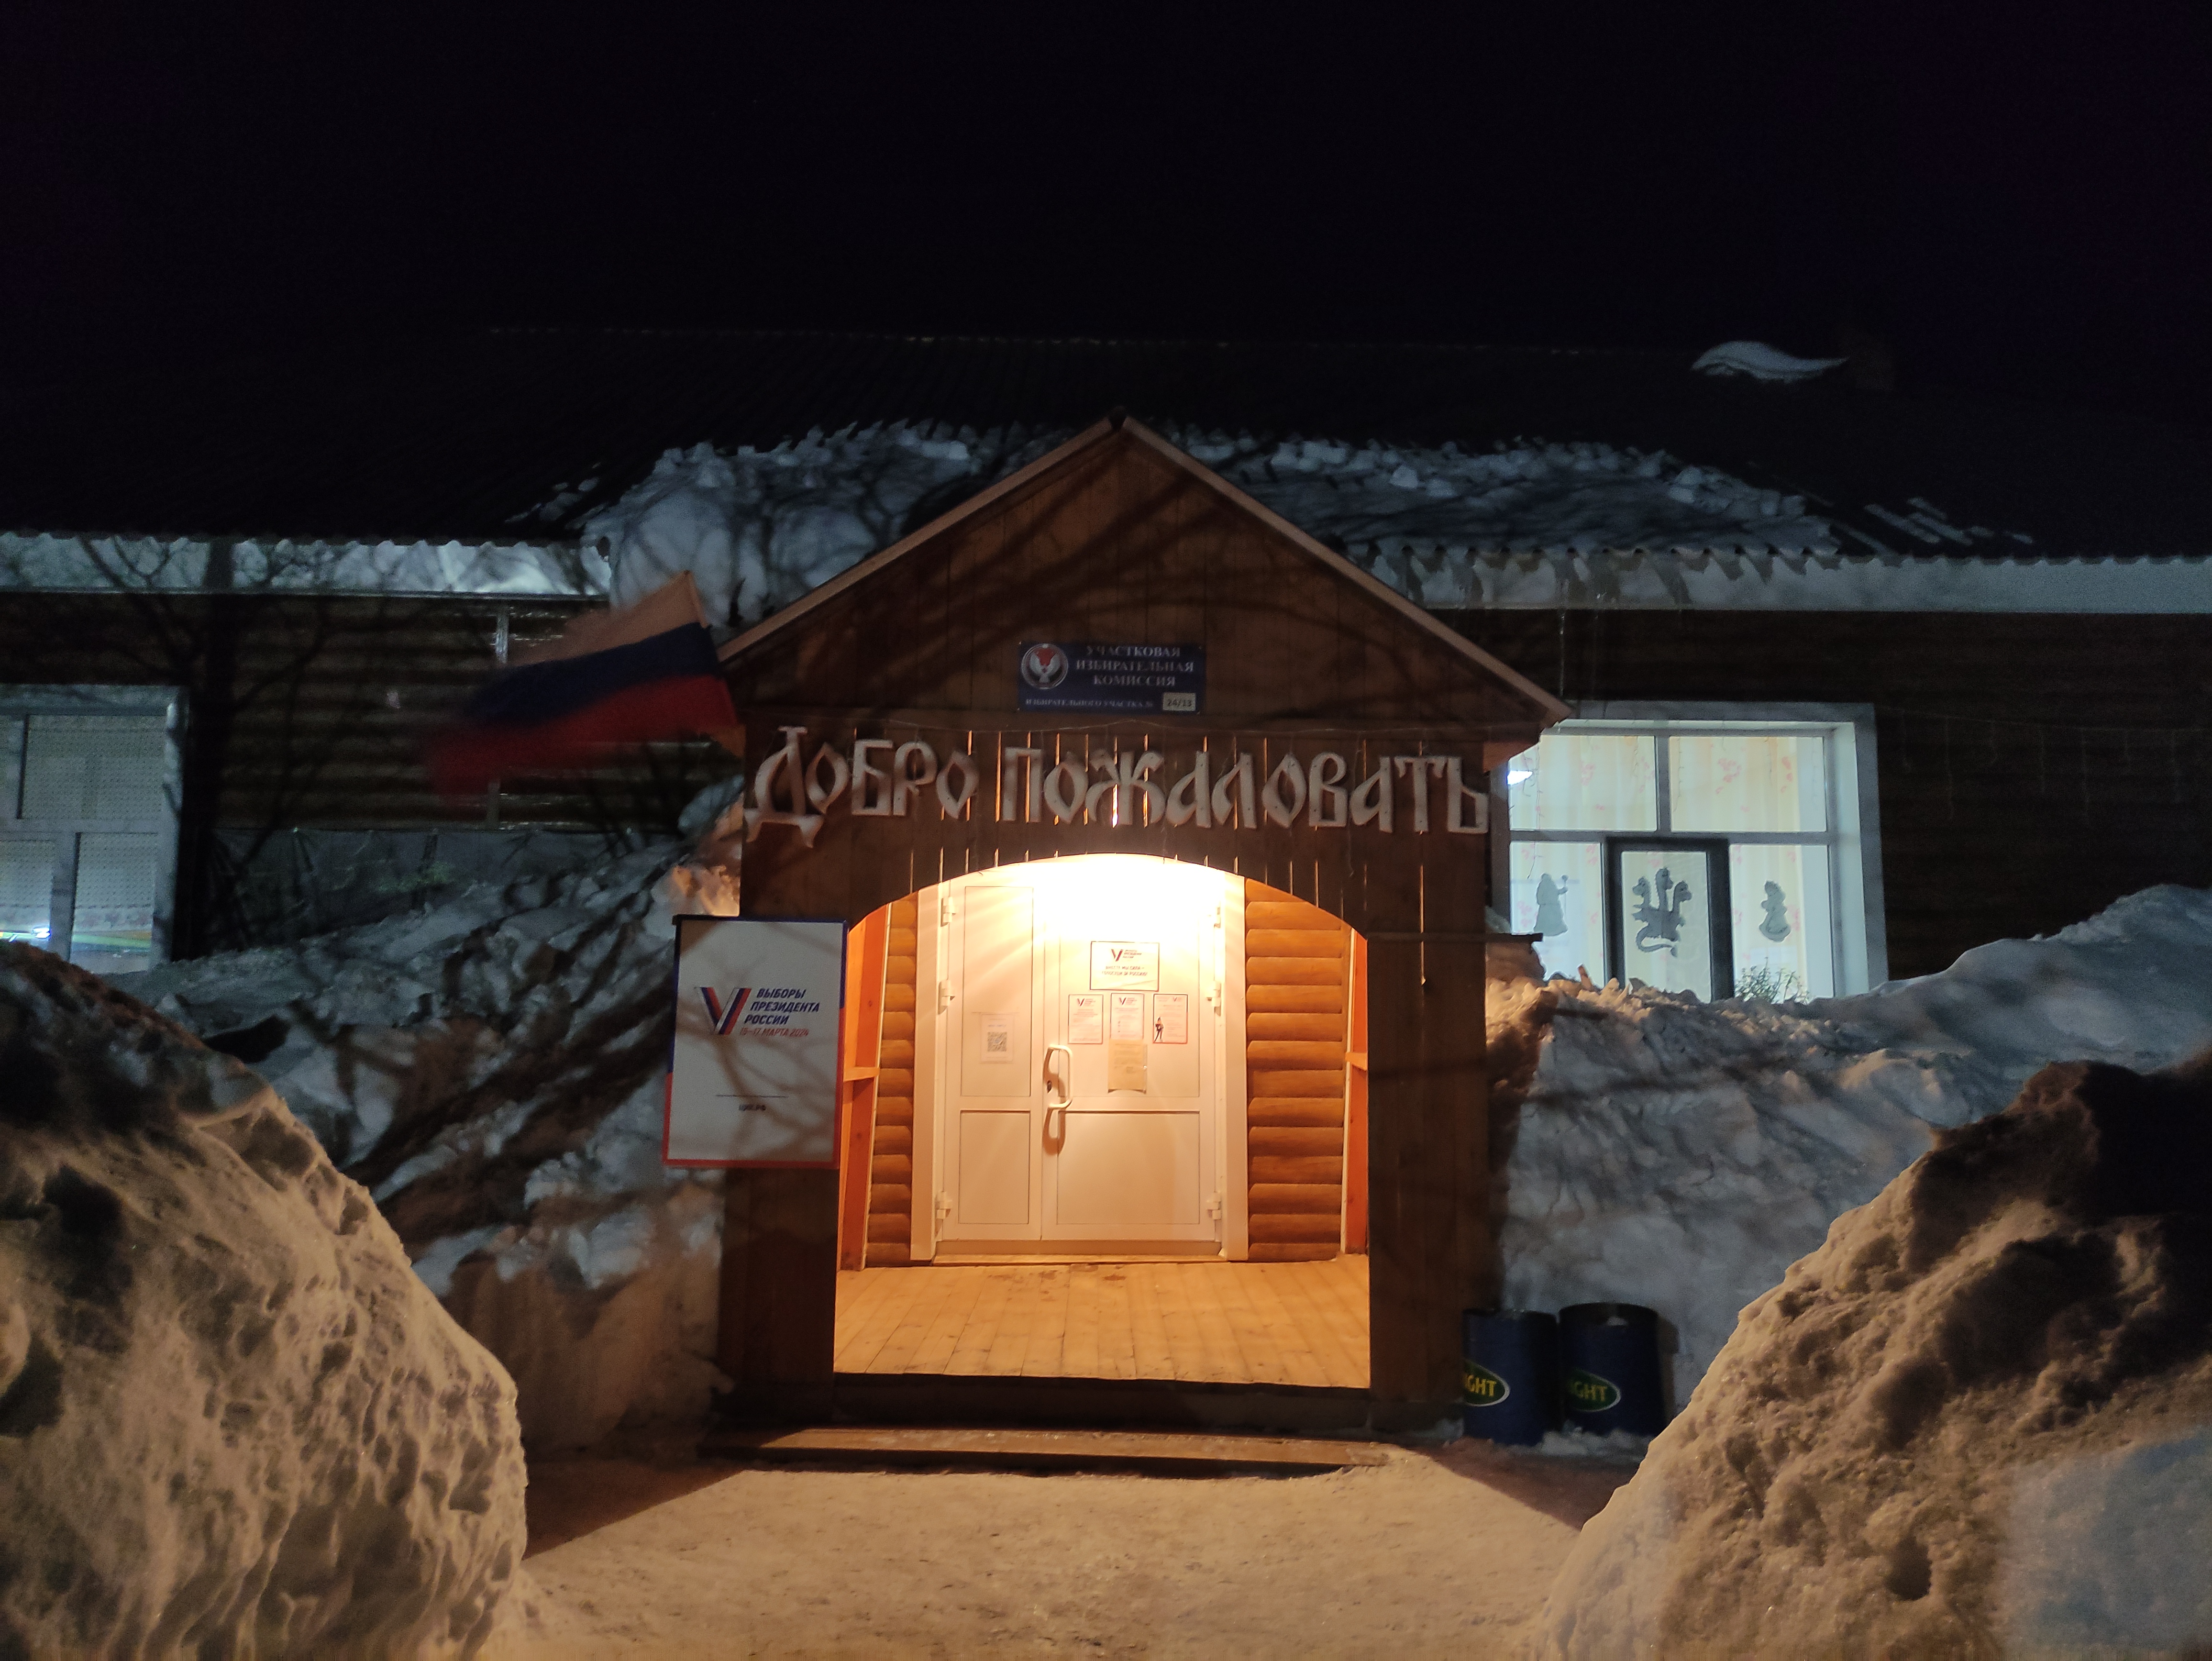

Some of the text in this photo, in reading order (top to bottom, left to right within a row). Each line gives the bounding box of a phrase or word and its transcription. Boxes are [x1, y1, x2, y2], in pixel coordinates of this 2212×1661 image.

[1086, 645, 1181, 658] УЧАСТКОВАЯ
[1075, 660, 1195, 673] ИЗБИРАТЕЛЬНАЯ
[1093, 675, 1177, 687] КОМИССИЯ
[756, 988, 806, 998] ВЫБОРЫ
[750, 1001, 820, 1013] ПРЕЗИДЕНТА
[744, 1014, 789, 1025] РОССИИ
[762, 1028, 789, 1036] МАРТА
[789, 1028, 809, 1037] 2024
